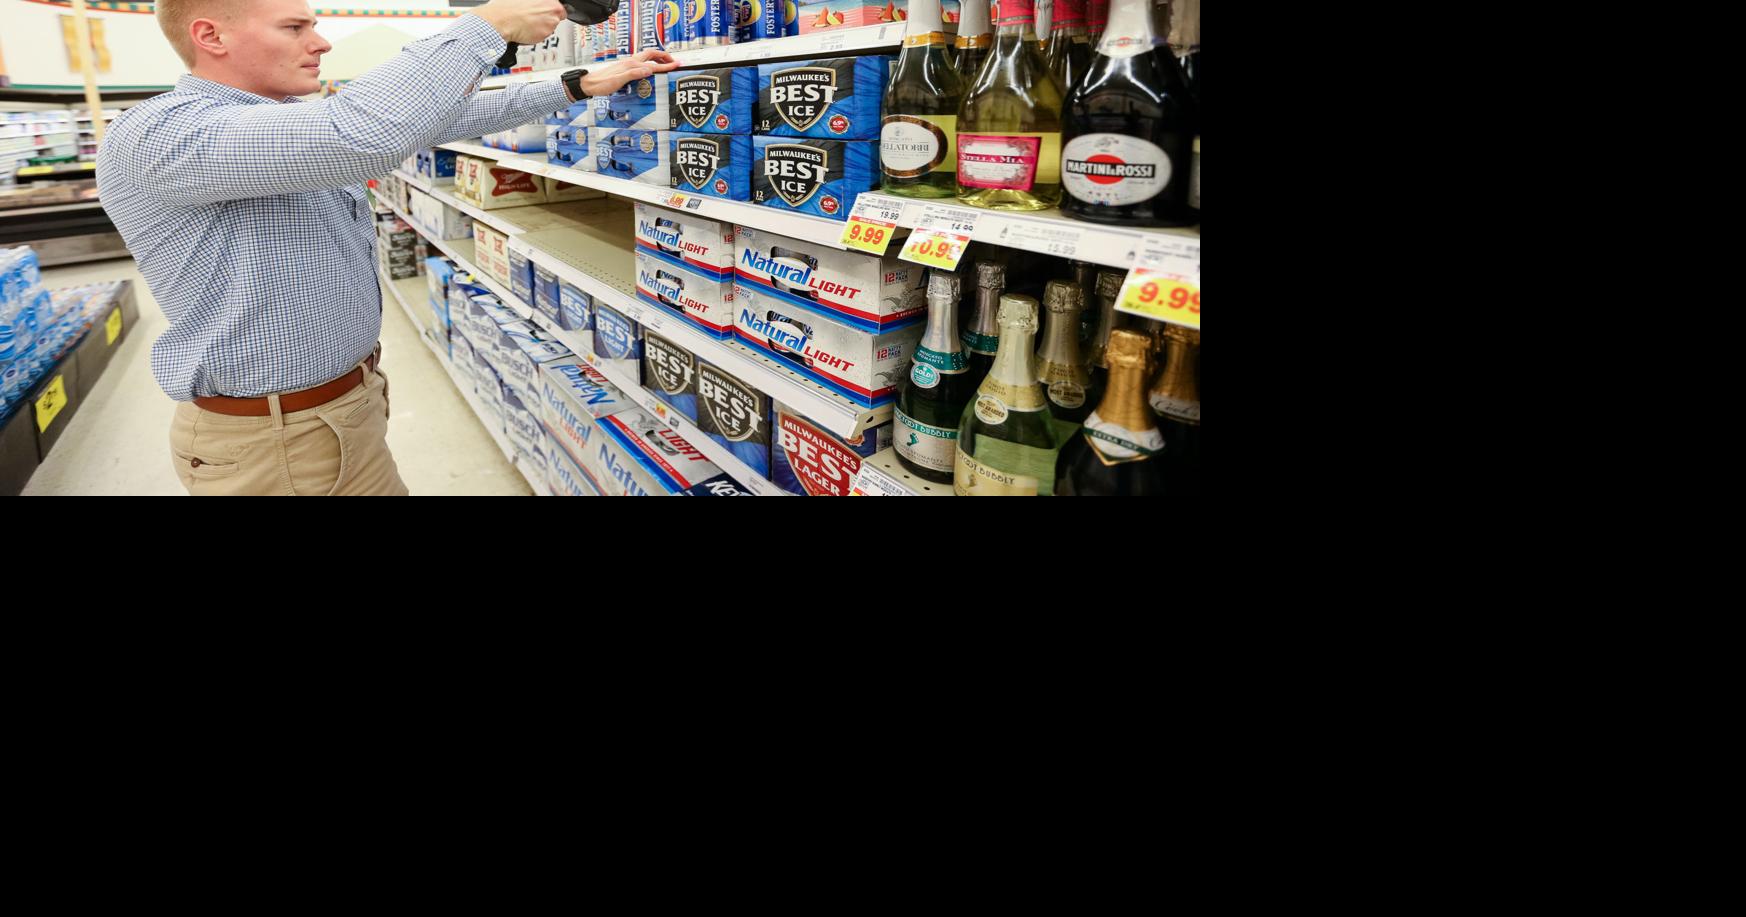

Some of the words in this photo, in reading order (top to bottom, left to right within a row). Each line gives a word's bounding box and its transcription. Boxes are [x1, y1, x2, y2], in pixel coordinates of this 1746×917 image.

[776, 74, 830, 84] MILWAUKEE'S
[676, 89, 721, 105] BEST
[770, 84, 838, 104] BEST
[688, 106, 706, 116] ICE
[788, 105, 815, 116] ICE
[681, 143, 715, 152] MILWAUKEE'S
[769, 150, 822, 162] MILWAUKEE'S
[676, 151, 720, 170] BEST
[960, 153, 996, 163] STELLA
[1000, 155, 1025, 164] MIA
[688, 168, 706, 178] ICE
[764, 160, 829, 184] BEST
[781, 181, 806, 193] ICE
[880, 211, 900, 221] 19.99
[639, 220, 680, 247] Natural
[678, 240, 709, 256] LIGHT
[724, 235, 734, 244] 12
[849, 224, 885, 245] 9.99
[741, 248, 812, 285] Natural
[808, 277, 861, 300] LIGHT
[884, 272, 895, 283] 12
[640, 270, 680, 301] Natural
[679, 296, 709, 313] LIGHT
[724, 294, 734, 302] 12
[597, 316, 635, 350] BEST
[739, 309, 808, 353] Natural
[803, 346, 855, 372] LIGHT
[648, 336, 689, 364] MILWAUKEE'S
[877, 348, 888, 361] 12
[645, 344, 694, 385] BEST
[658, 367, 679, 388] ICE
[702, 370, 754, 407] MILWAUKEE'S
[543, 382, 593, 441] Natural
[699, 380, 763, 432] BEST
[716, 406, 741, 432] ICE
[658, 428, 710, 462] LIGHT
[784, 420, 858, 470] MILWAUKEE'S
[794, 457, 841, 496] LAGER
